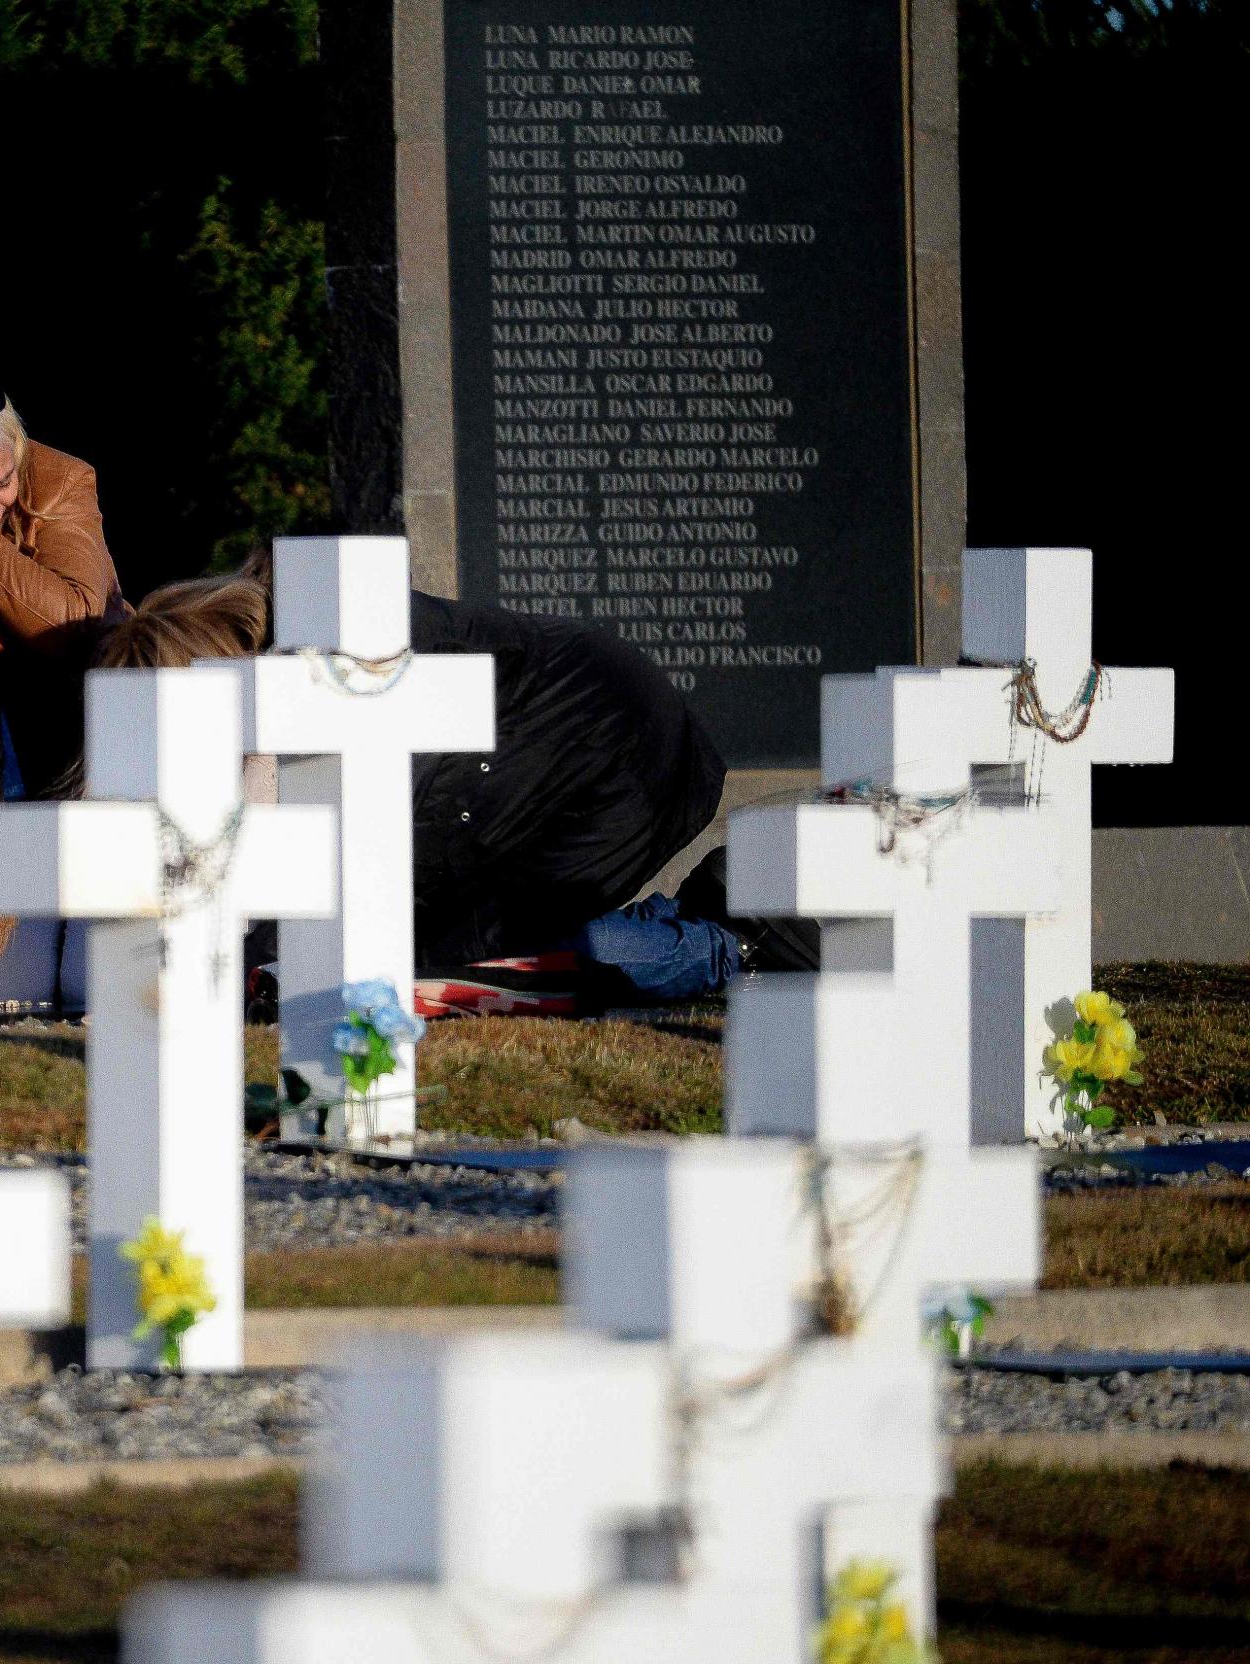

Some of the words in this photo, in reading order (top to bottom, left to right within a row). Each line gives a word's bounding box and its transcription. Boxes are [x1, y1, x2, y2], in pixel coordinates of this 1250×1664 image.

[485, 26, 538, 44] LUNA
[549, 26, 616, 44] MARIO
[620, 26, 694, 44] RAMON
[486, 51, 539, 69] LUNA
[549, 51, 639, 69] RICARDO
[644, 51, 691, 71] JOSE
[486, 76, 554, 98] LUQUE
[564, 76, 637, 94] DANIEL
[641, 76, 701, 94] OMAR
[487, 101, 582, 118] LUZARDO
[487, 126, 565, 144] MACIEL
[574, 126, 662, 147] ENRIQUE
[666, 126, 784, 144] ALEJANDRO
[488, 151, 566, 169] MACIEL
[575, 151, 684, 169] GERONIMO
[488, 176, 566, 193] MACIEL
[575, 176, 650, 193] IRENEO
[654, 176, 746, 193] OSVALDO
[489, 200, 567, 219] MACIEL
[575, 200, 640, 221] JORGE
[645, 200, 738, 218] ALFREDO
[490, 225, 567, 243] MACIEL
[576, 225, 655, 243] MARTIN
[659, 225, 719, 243] OMAR
[724, 225, 816, 243] AUGUSTO
[490, 251, 571, 268] MADRID
[579, 250, 640, 268] OMAR
[644, 250, 737, 268] ALFREDO
[491, 275, 604, 293] MAGLIOTTI
[612, 275, 686, 293] SERGIO
[691, 275, 764, 292] DANIEL
[492, 300, 585, 318] MAIDANA
[594, 300, 652, 320] JULIO
[657, 300, 739, 317] HECTOR
[492, 325, 621, 343] MALDONADO
[630, 324, 677, 345] JOSE
[683, 324, 773, 342] ALBERTO
[493, 350, 577, 368] MAMANI
[586, 350, 647, 370] JUSTO
[652, 349, 762, 371] EUSTAQUIO
[494, 375, 595, 393] MANSILLA
[605, 375, 672, 393] OSCAR
[676, 375, 773, 392] EDGARDO
[494, 400, 599, 418] MANZOTTI
[608, 400, 681, 417] DANIEL
[686, 399, 793, 417] FERNANDO
[495, 425, 630, 443] MARAGLIANO
[640, 424, 725, 442] SAVERIO
[729, 424, 777, 444] JOSE
[495, 449, 610, 468] MARCHISIO
[619, 449, 716, 467] GERARDO
[720, 448, 819, 467] MARCELO
[496, 474, 589, 493] MARCIAL
[598, 474, 699, 492] EDMUNDO
[703, 473, 803, 492] FEDERICO
[496, 499, 590, 517] MARCIAL
[600, 499, 658, 519] JESUS
[662, 498, 755, 517] ARTEMIO
[497, 524, 589, 542] MARIZZA
[598, 523, 663, 542] GUIDO
[667, 523, 757, 541] ANTONIO
[498, 548, 598, 571] MARQUEZ
[607, 548, 705, 567] MARCELO
[710, 547, 798, 566] GUSTAVO
[499, 573, 598, 596] MARQUEZ
[607, 573, 674, 592] RUBEN
[678, 572, 772, 591] EDUARDO
[591, 597, 657, 616] RUBEN
[662, 597, 744, 615] HECTOR
[618, 622, 663, 641] LUIS
[667, 622, 747, 641] CARLOS
[710, 645, 821, 666] FRANCISCO
